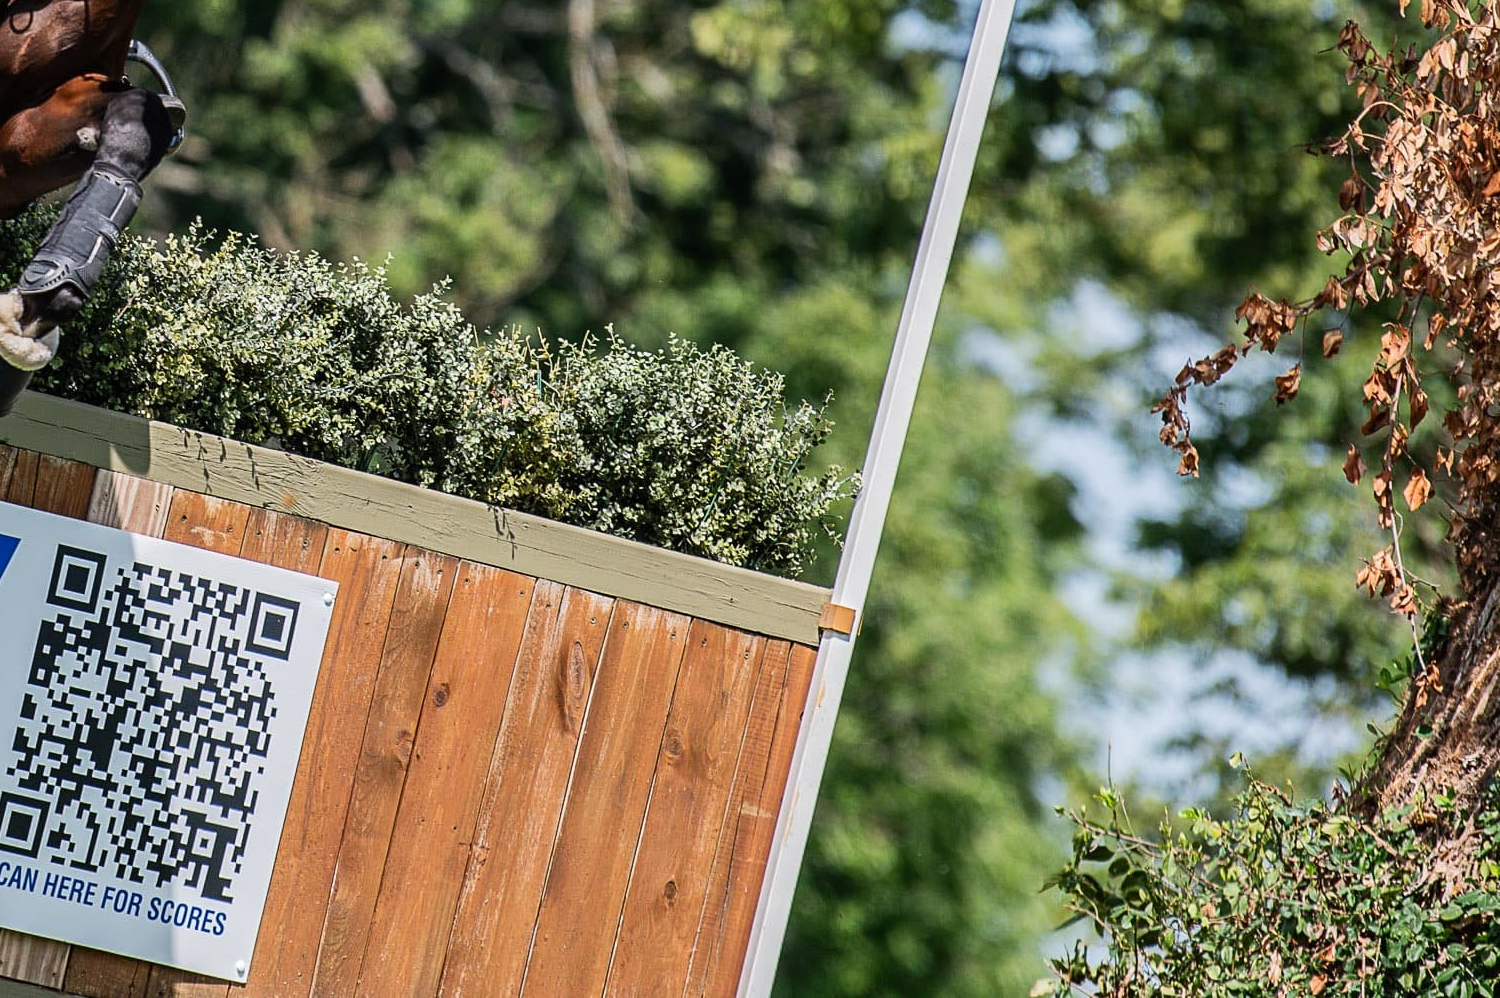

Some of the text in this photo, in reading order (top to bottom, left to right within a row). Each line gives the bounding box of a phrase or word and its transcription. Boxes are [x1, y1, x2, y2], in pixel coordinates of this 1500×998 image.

[42, 872, 98, 906] HERE
[101, 886, 143, 916] FOR
[147, 897, 227, 935] SCORES
